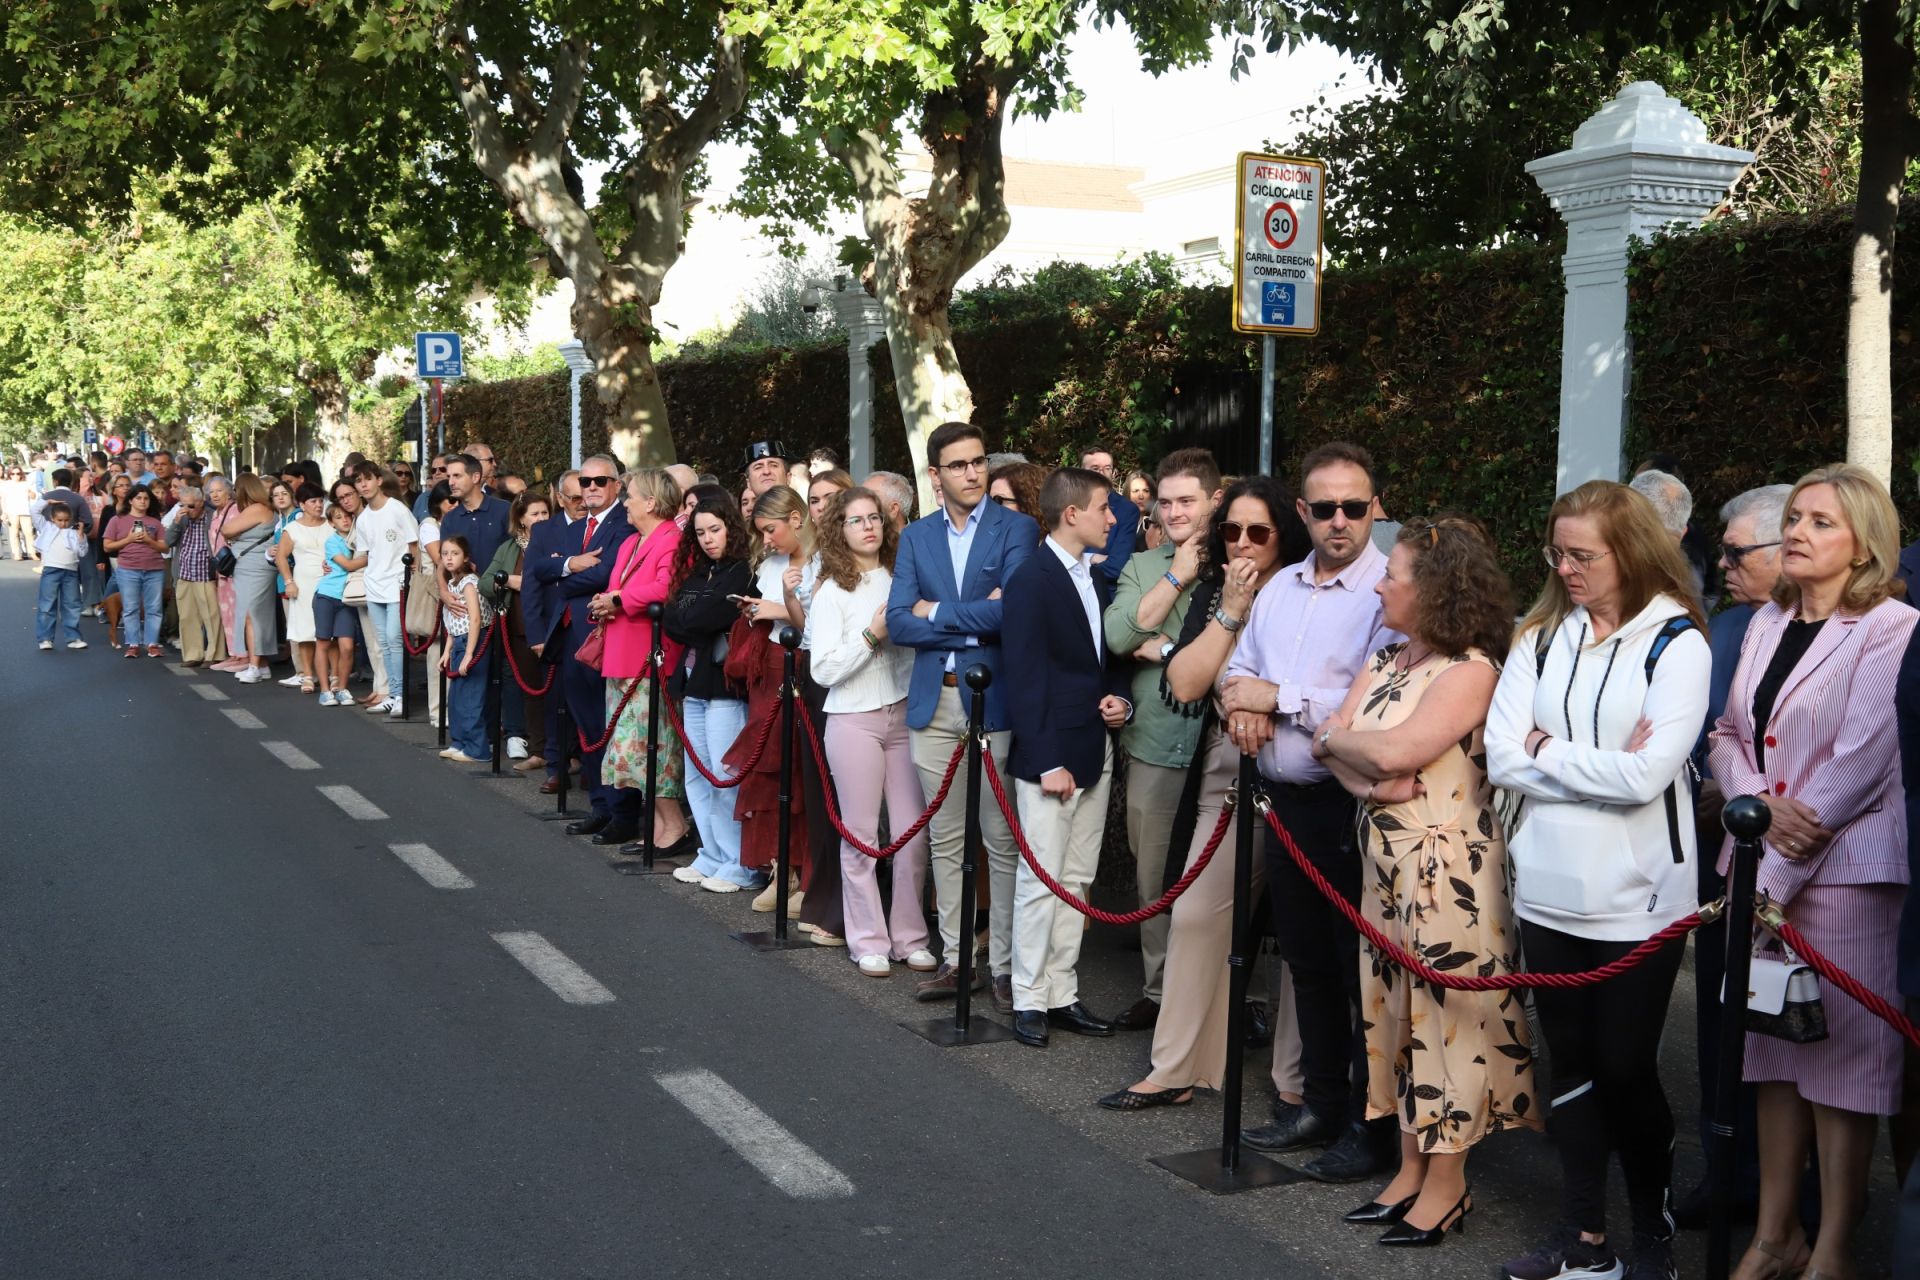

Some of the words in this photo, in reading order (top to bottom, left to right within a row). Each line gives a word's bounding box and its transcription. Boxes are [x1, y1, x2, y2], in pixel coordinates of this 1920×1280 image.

[1254, 166, 1312, 184] ATENCIÓN
[1251, 184, 1313, 201] CICLOCALLE
[1272, 218, 1290, 233] 30
[1245, 252, 1275, 264] CARRIL
[1276, 254, 1315, 267] DERECHO
[1253, 266, 1306, 279] COMPARTIDO
[425, 338, 452, 371] P
[1688, 757, 1701, 782] Quechu
